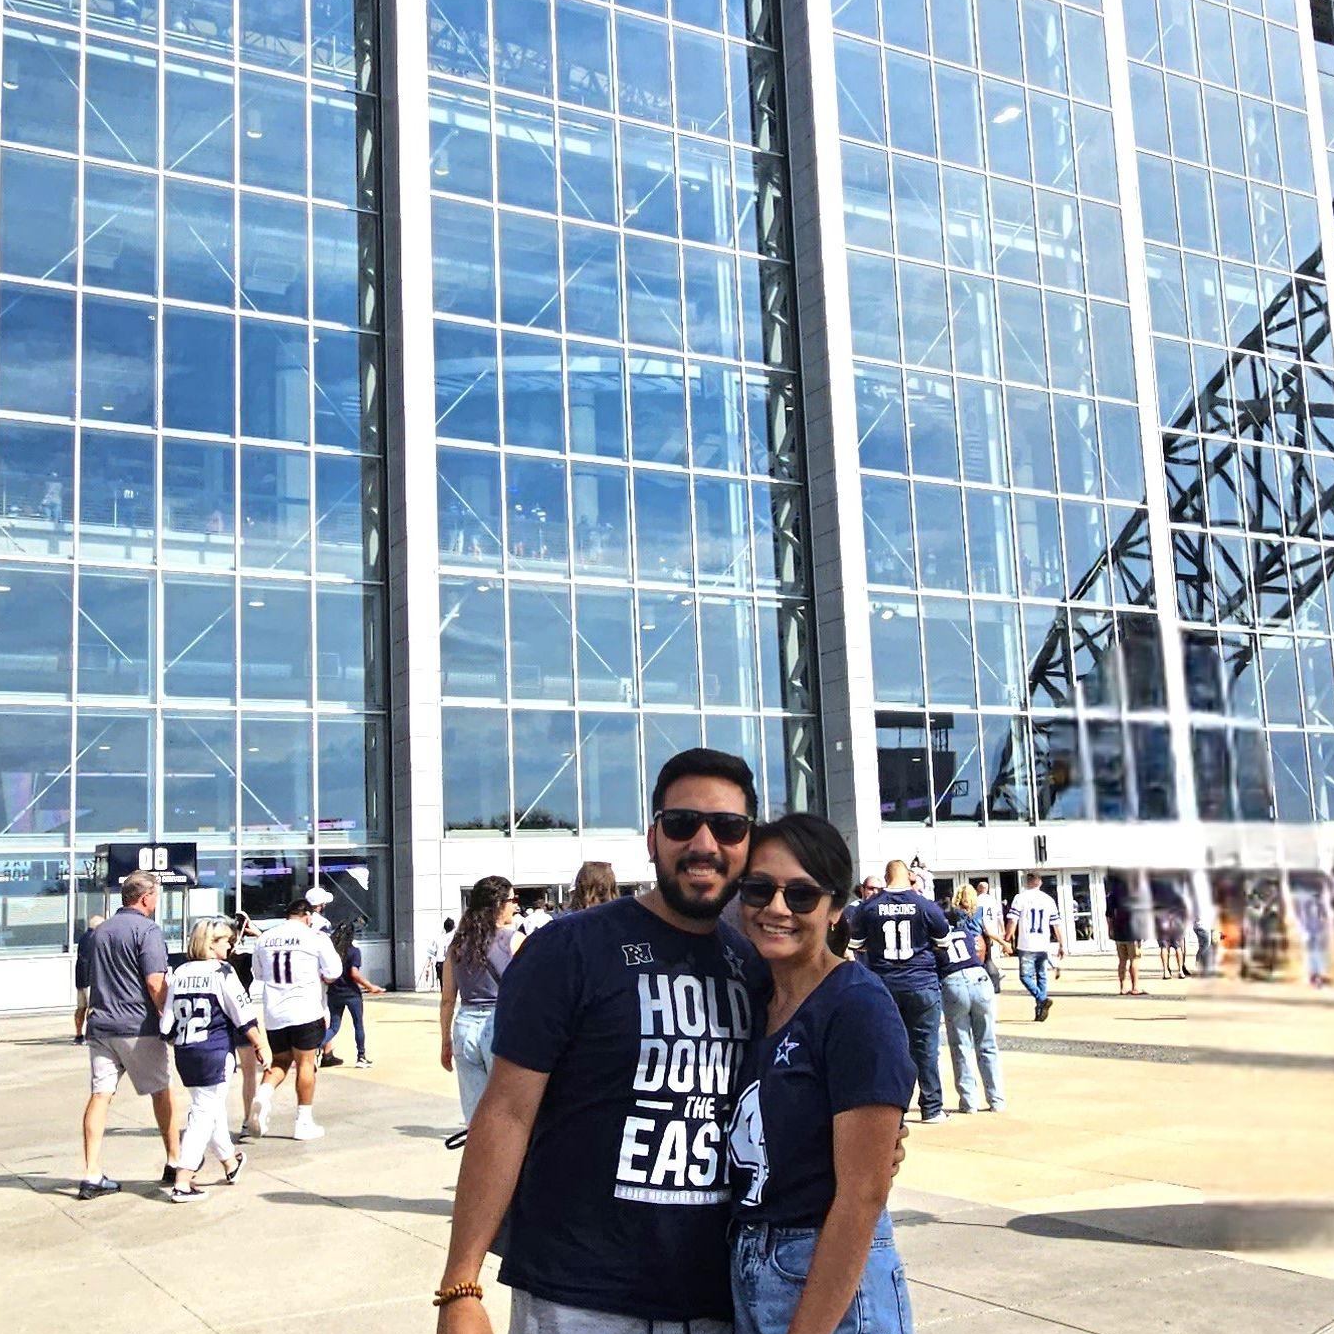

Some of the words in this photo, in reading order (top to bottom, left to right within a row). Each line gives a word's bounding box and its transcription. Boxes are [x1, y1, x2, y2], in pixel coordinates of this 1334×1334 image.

[878, 903, 917, 916] PARSONS
[1029, 908, 1045, 934] 11
[264, 937, 300, 948] EDELMAN
[882, 920, 915, 961] 11
[272, 950, 293, 984] 11
[173, 998, 212, 1046] 82
[638, 973, 753, 1041] HOLD
[683, 1096, 716, 1120] THE
